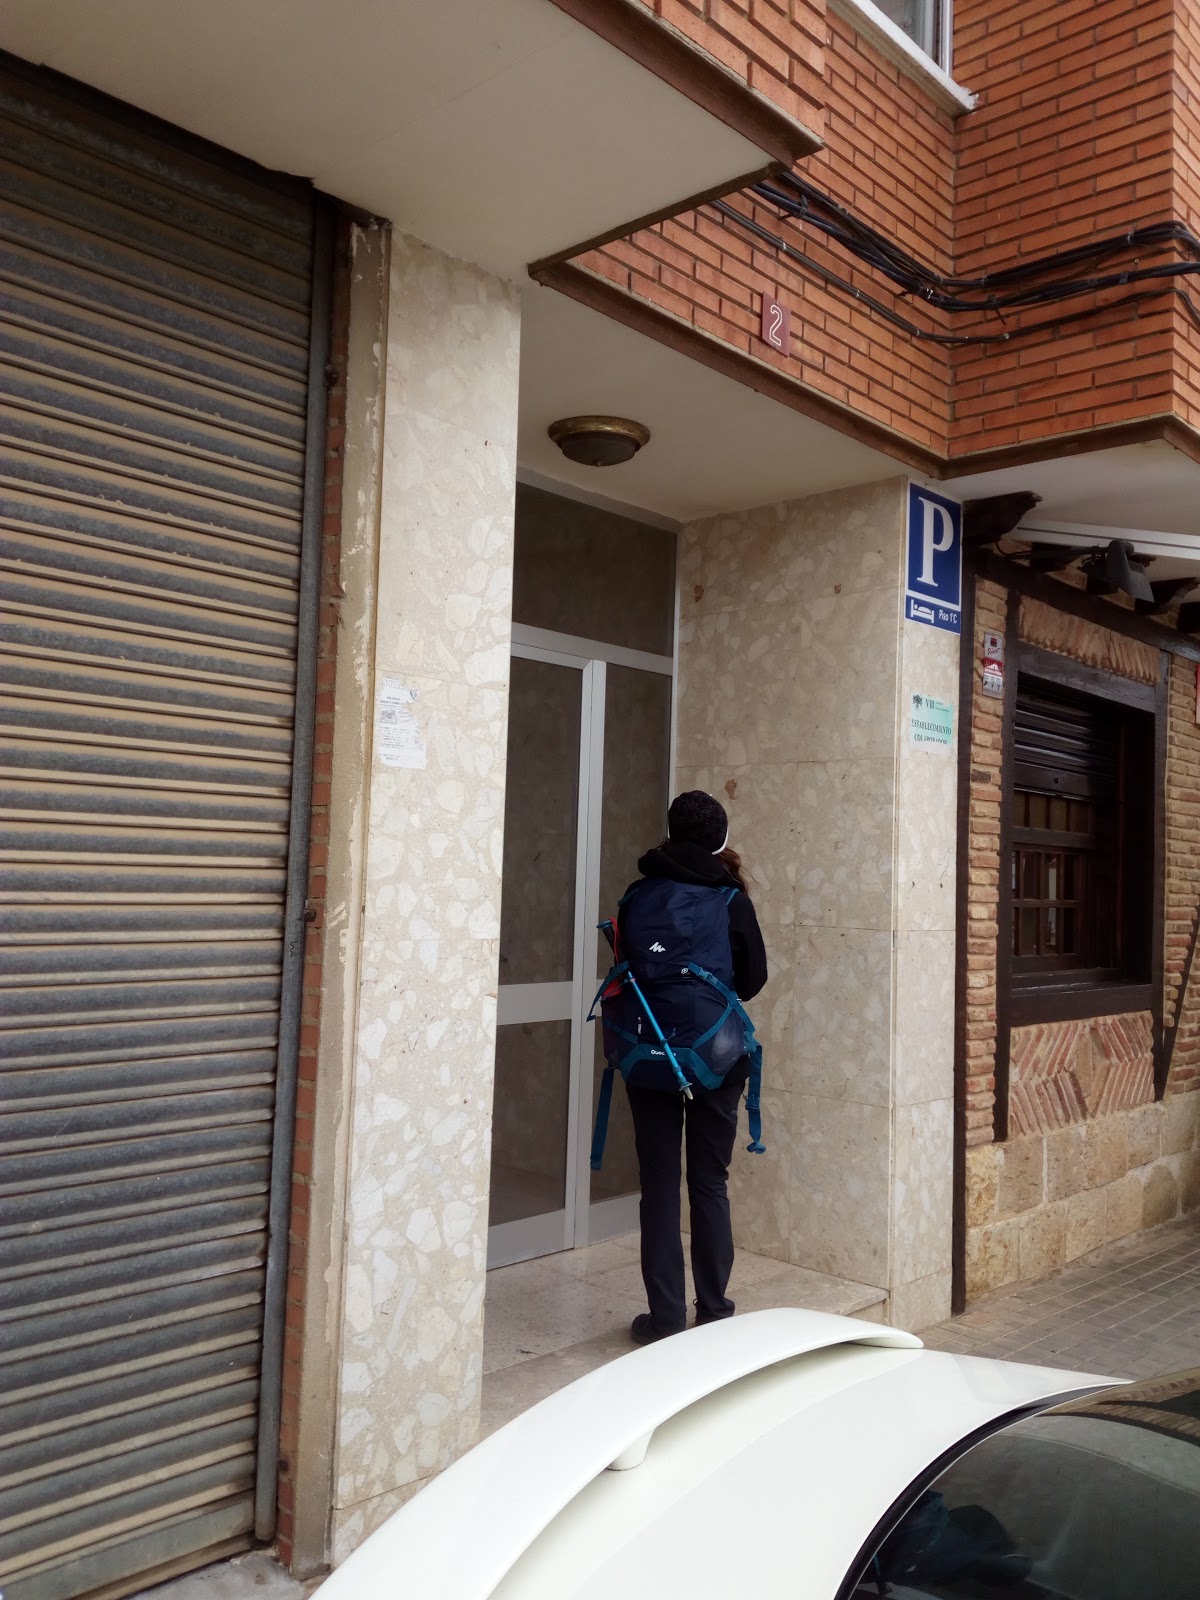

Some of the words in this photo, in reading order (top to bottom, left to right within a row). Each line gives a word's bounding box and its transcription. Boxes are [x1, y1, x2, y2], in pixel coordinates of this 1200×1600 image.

[770, 304, 783, 346] 2
[916, 496, 954, 587] P
[938, 609, 949, 621] Piso
[911, 718, 952, 735] ESTABLECIMIENTO
